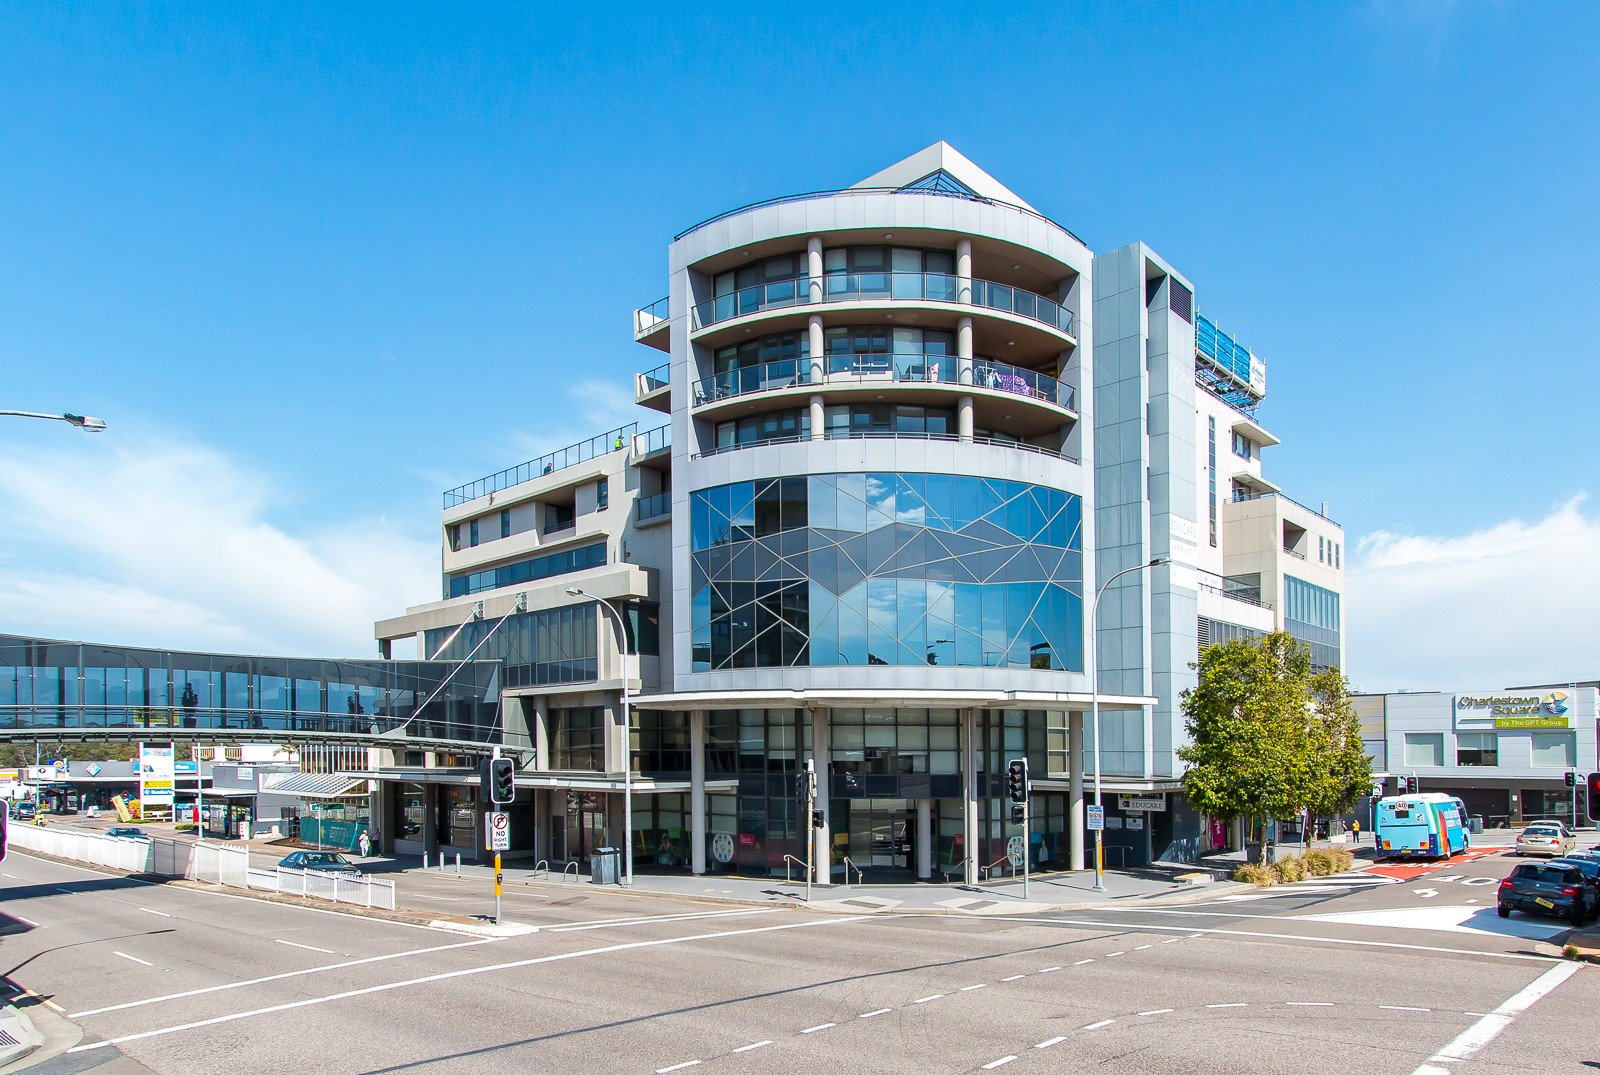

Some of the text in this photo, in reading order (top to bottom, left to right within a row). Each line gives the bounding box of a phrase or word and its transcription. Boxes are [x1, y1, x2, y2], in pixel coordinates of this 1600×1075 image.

[1460, 696, 1540, 707] Charlestown
[1492, 706, 1540, 715] Square
[1132, 801, 1162, 809] EDUCARE
